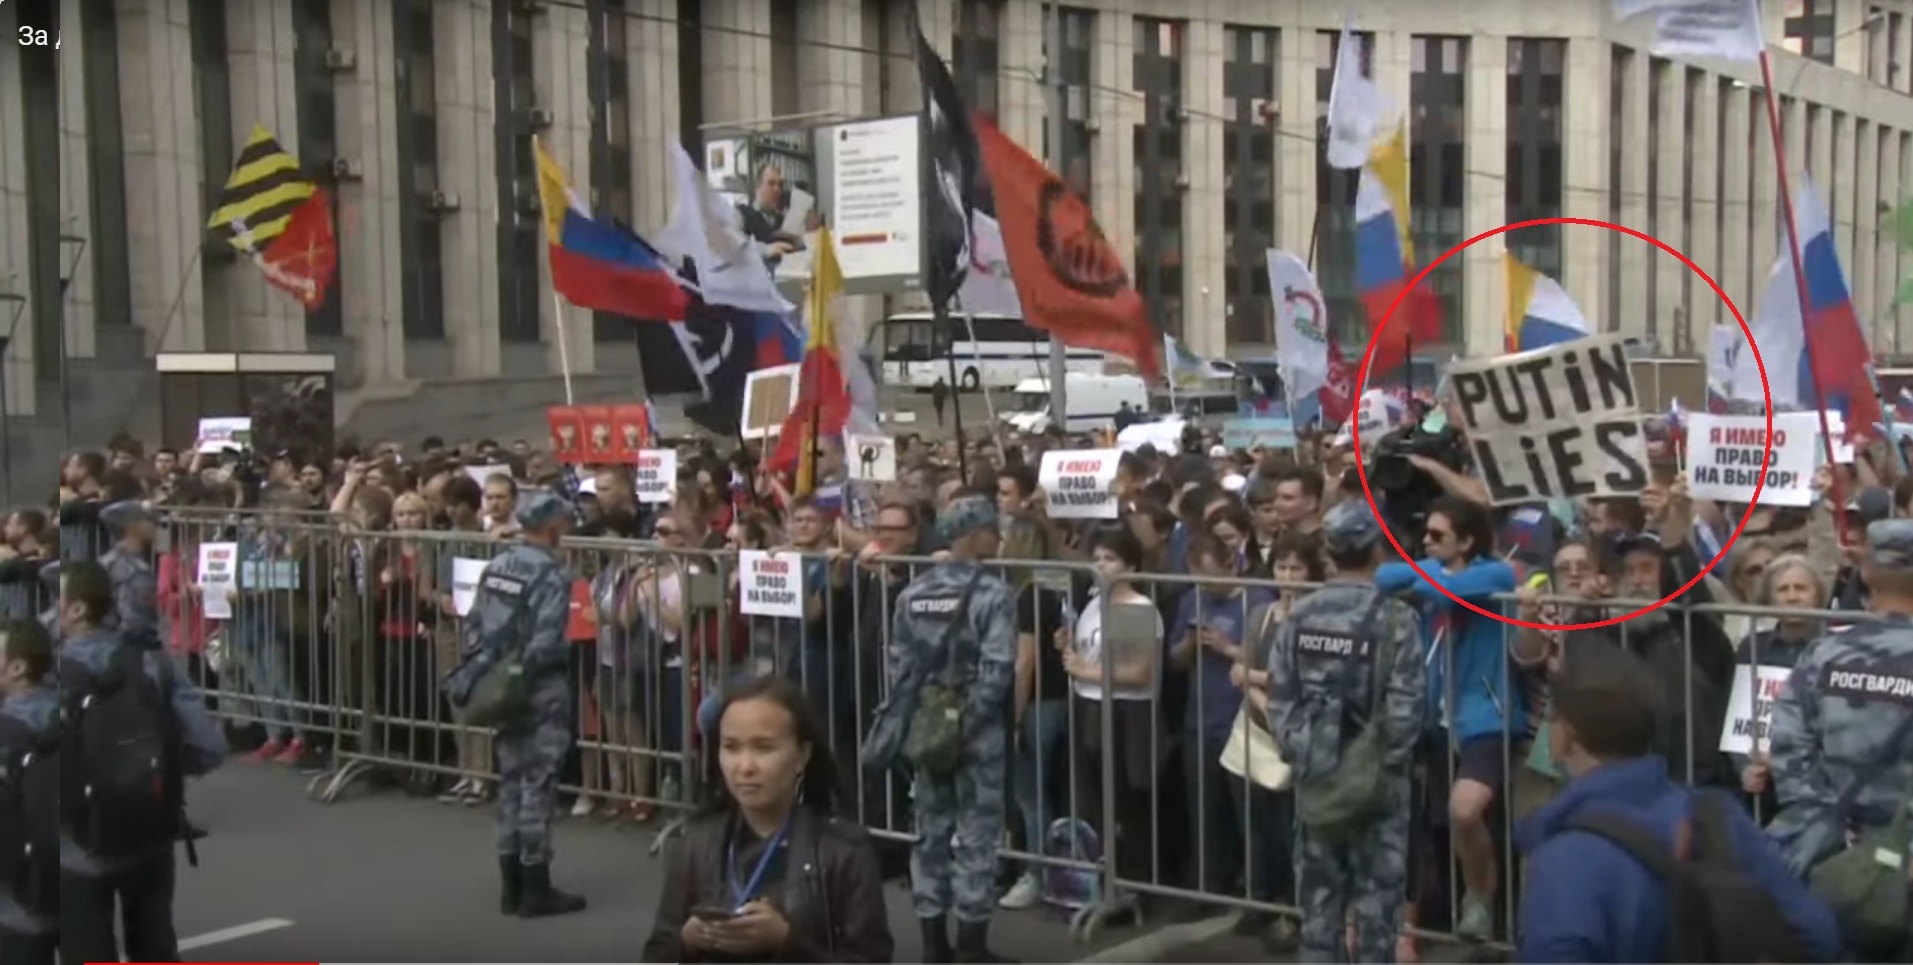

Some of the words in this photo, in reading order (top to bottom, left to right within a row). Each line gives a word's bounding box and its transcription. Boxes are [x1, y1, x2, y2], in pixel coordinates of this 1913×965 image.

[1709, 427, 1722, 445] Я
[1715, 448, 1779, 467] ПРАВО
[1058, 475, 1096, 490] ПРАВО
[1694, 467, 1720, 484] НА
[1723, 470, 1799, 489] ВЫБОР!
[1050, 492, 1067, 505] НА
[755, 574, 787, 589] ПРАВО
